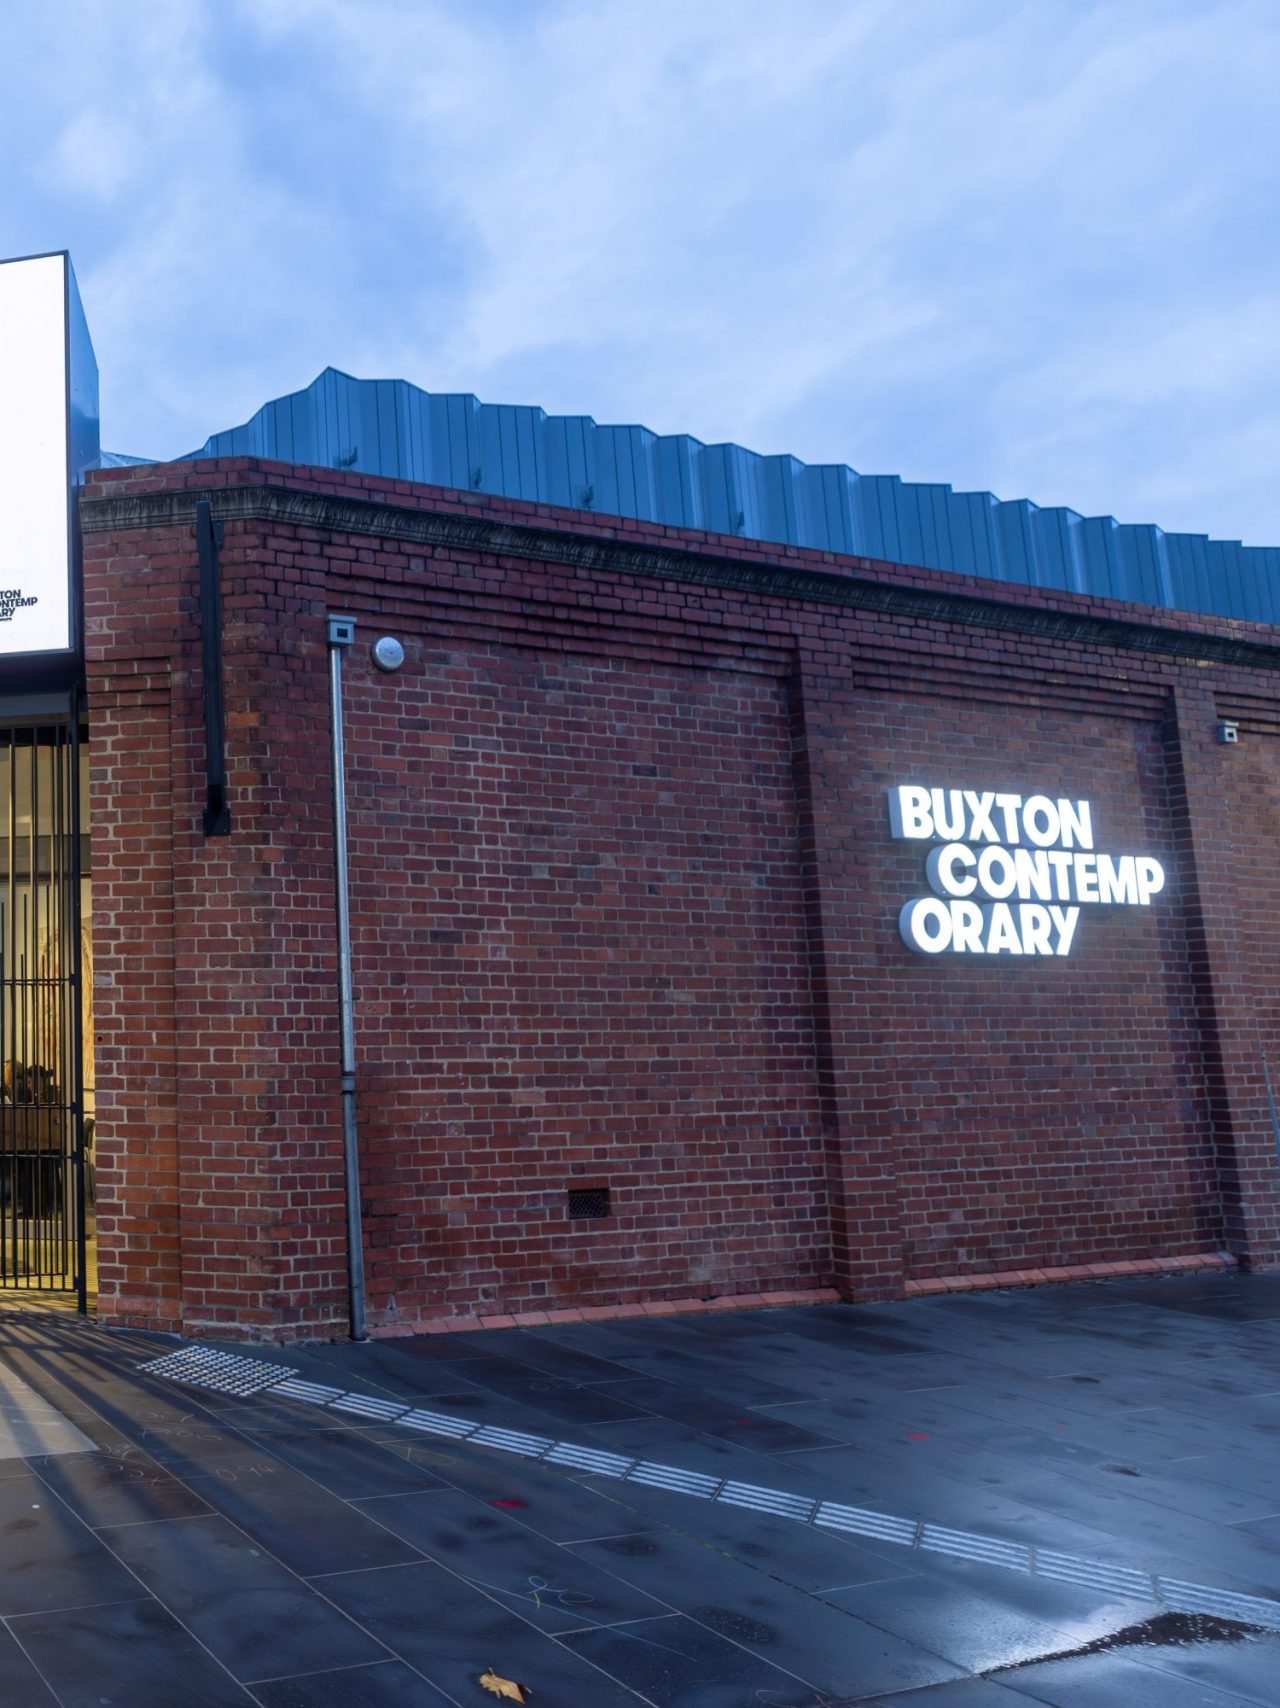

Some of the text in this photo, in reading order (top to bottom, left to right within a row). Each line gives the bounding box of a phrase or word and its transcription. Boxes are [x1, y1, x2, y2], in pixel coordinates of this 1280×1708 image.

[895, 785, 1094, 850] BUXTON
[934, 843, 1165, 906] CONTEMP
[907, 897, 1080, 957] ORARY
